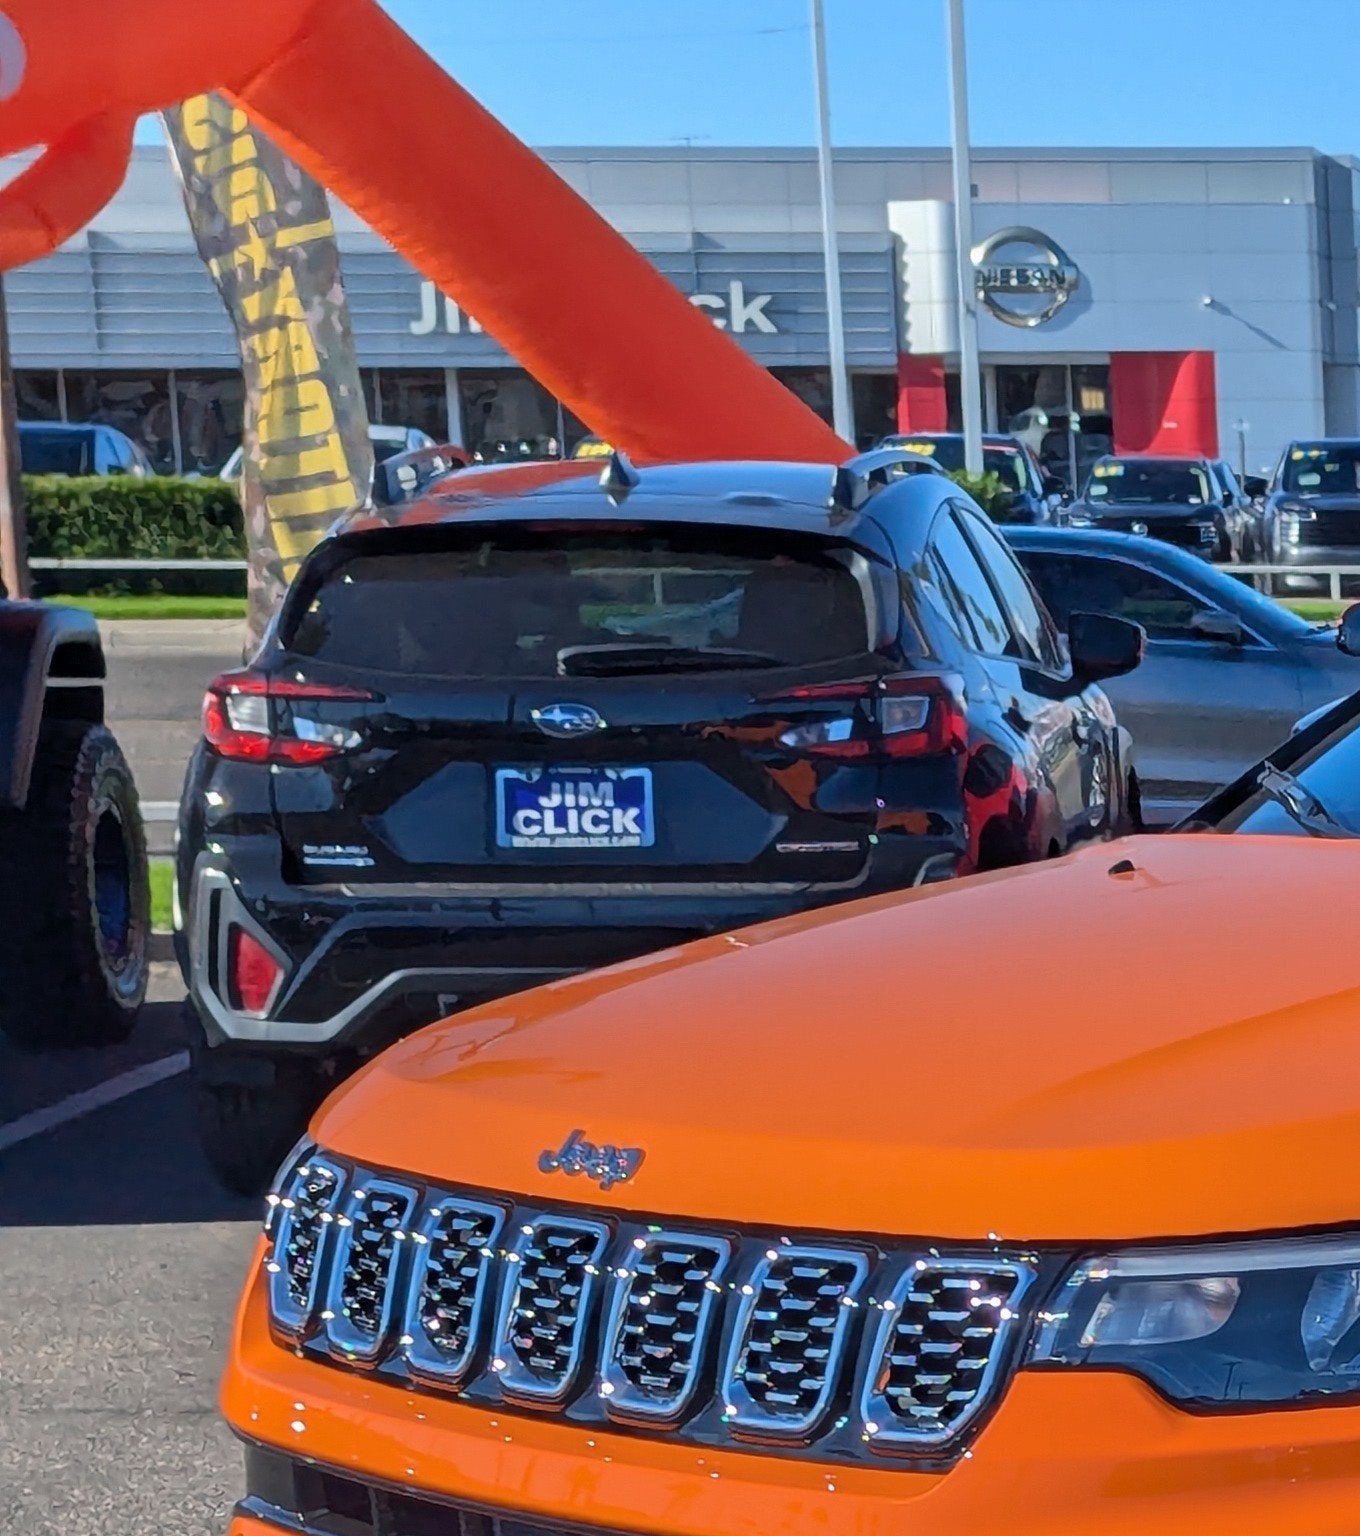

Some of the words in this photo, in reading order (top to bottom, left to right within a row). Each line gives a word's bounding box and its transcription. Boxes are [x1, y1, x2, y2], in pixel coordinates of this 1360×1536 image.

[409, 280, 484, 335] Ji
[538, 781, 615, 808] JIM
[512, 807, 642, 836] CLICK
[538, 1129, 646, 1191] Jeep
